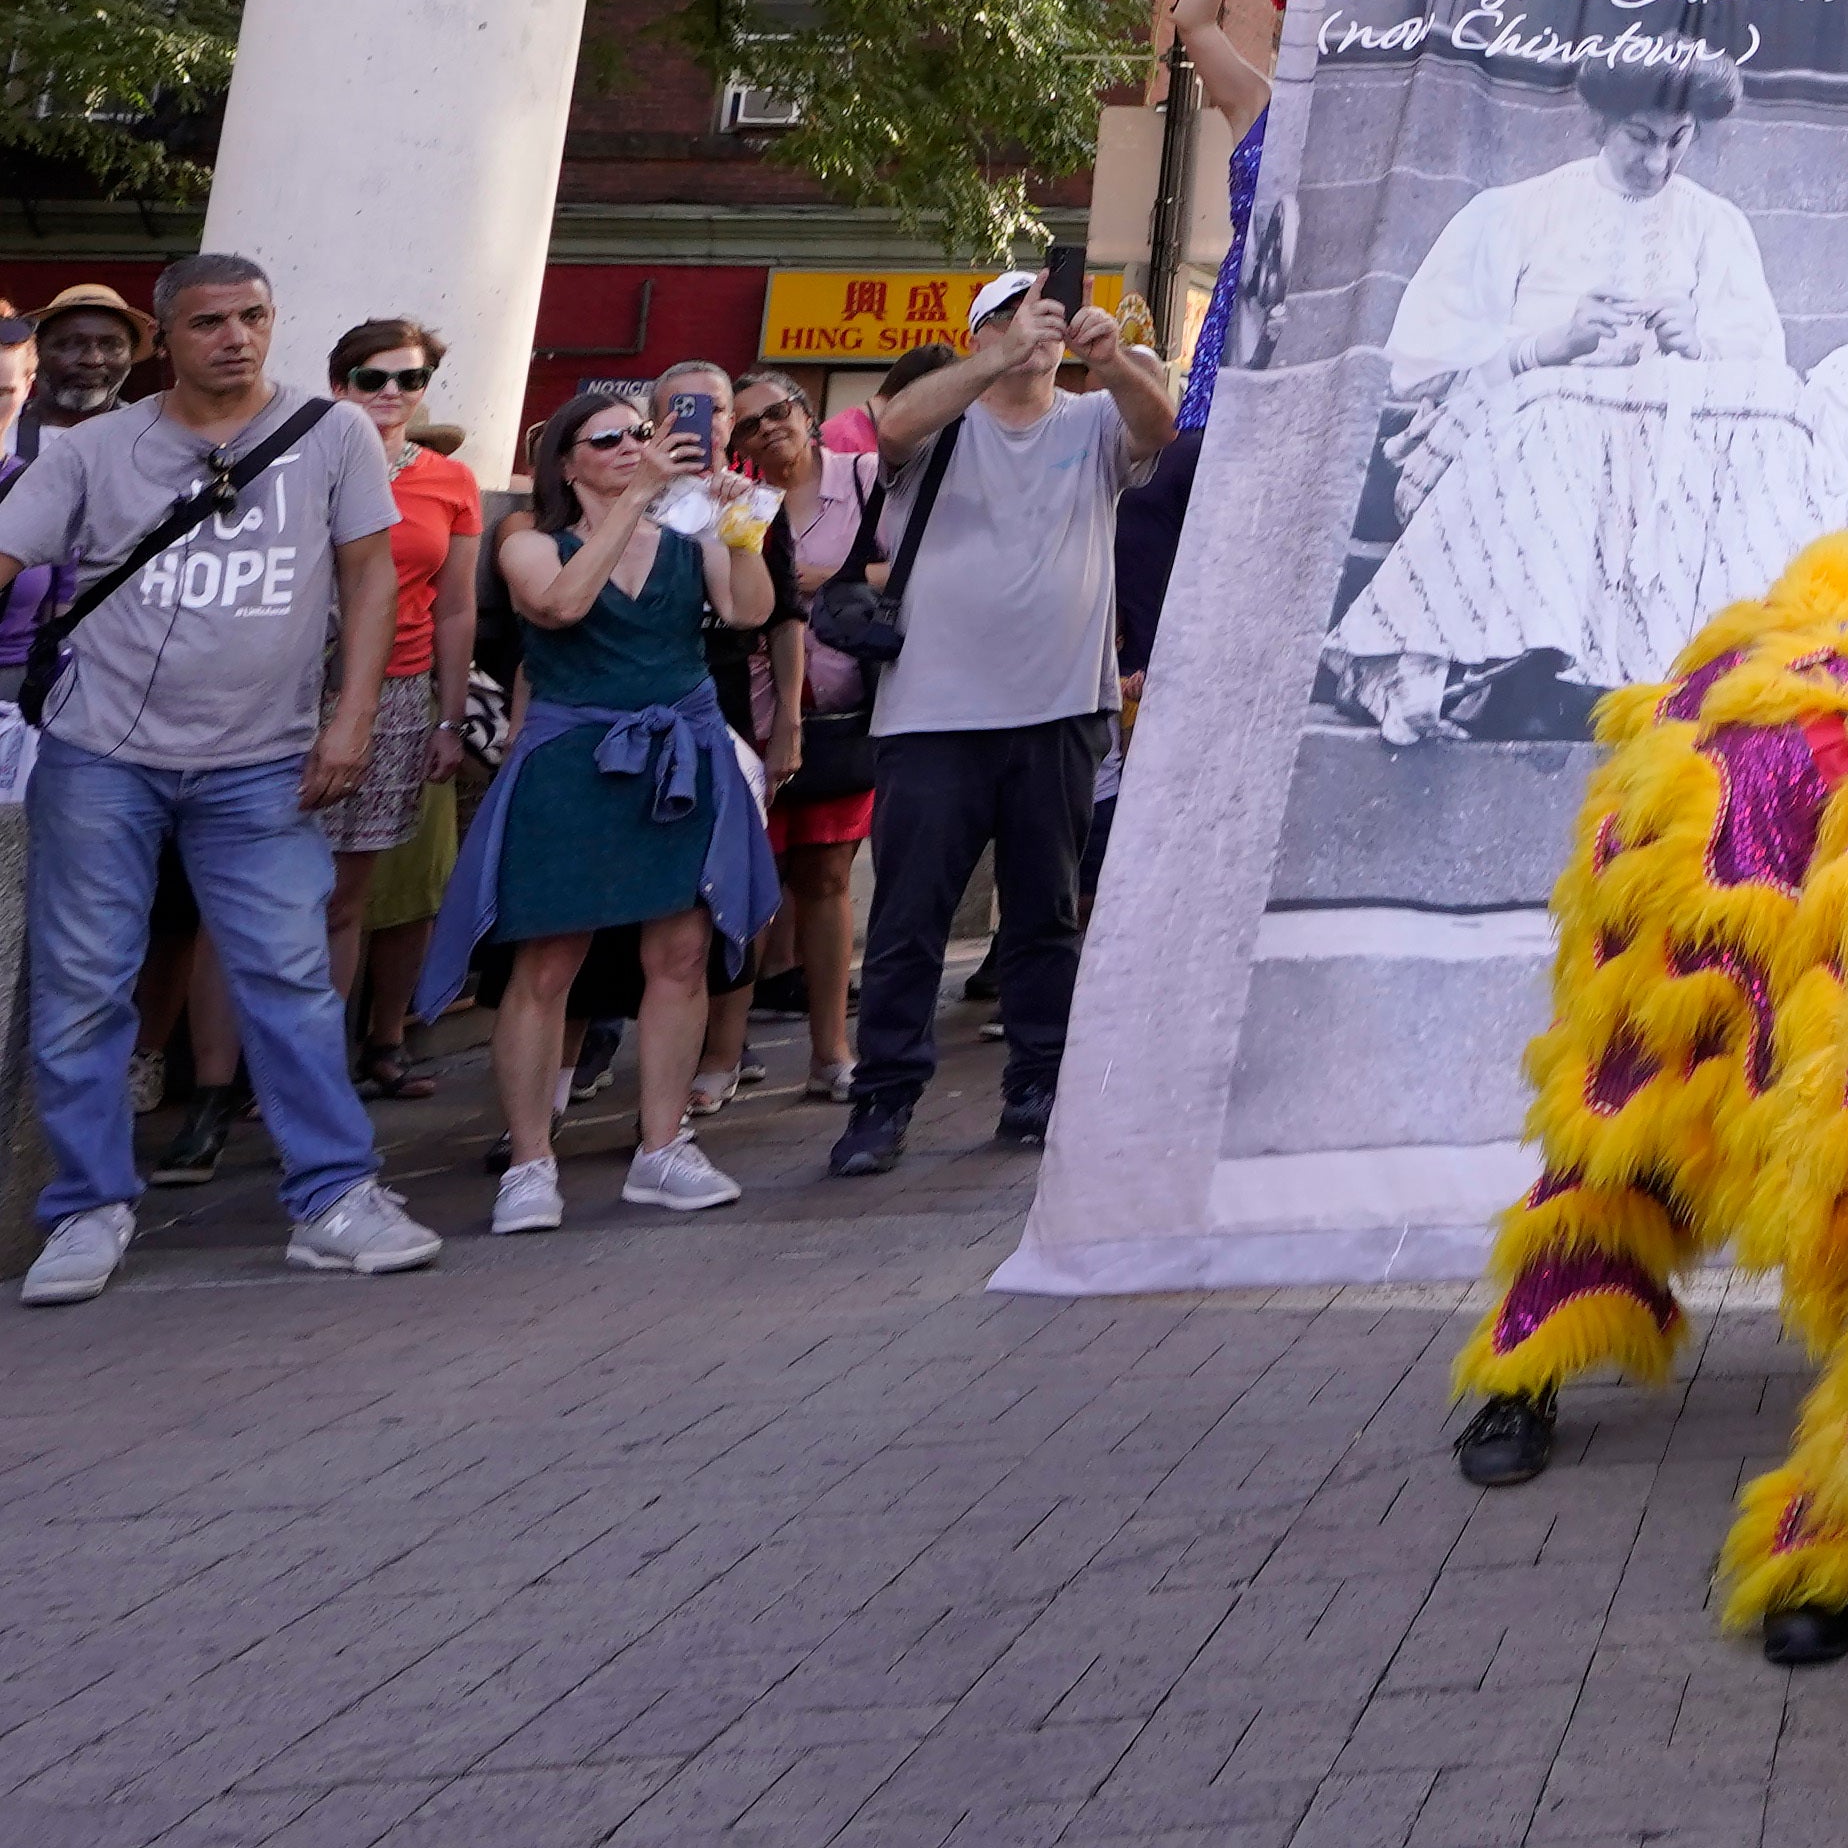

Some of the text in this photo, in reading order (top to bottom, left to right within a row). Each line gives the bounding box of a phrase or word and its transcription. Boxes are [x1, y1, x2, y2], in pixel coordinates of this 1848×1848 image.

[779, 326, 866, 352] HING
[586, 379, 658, 397] NOTICE
[139, 546, 297, 609] HOPE
